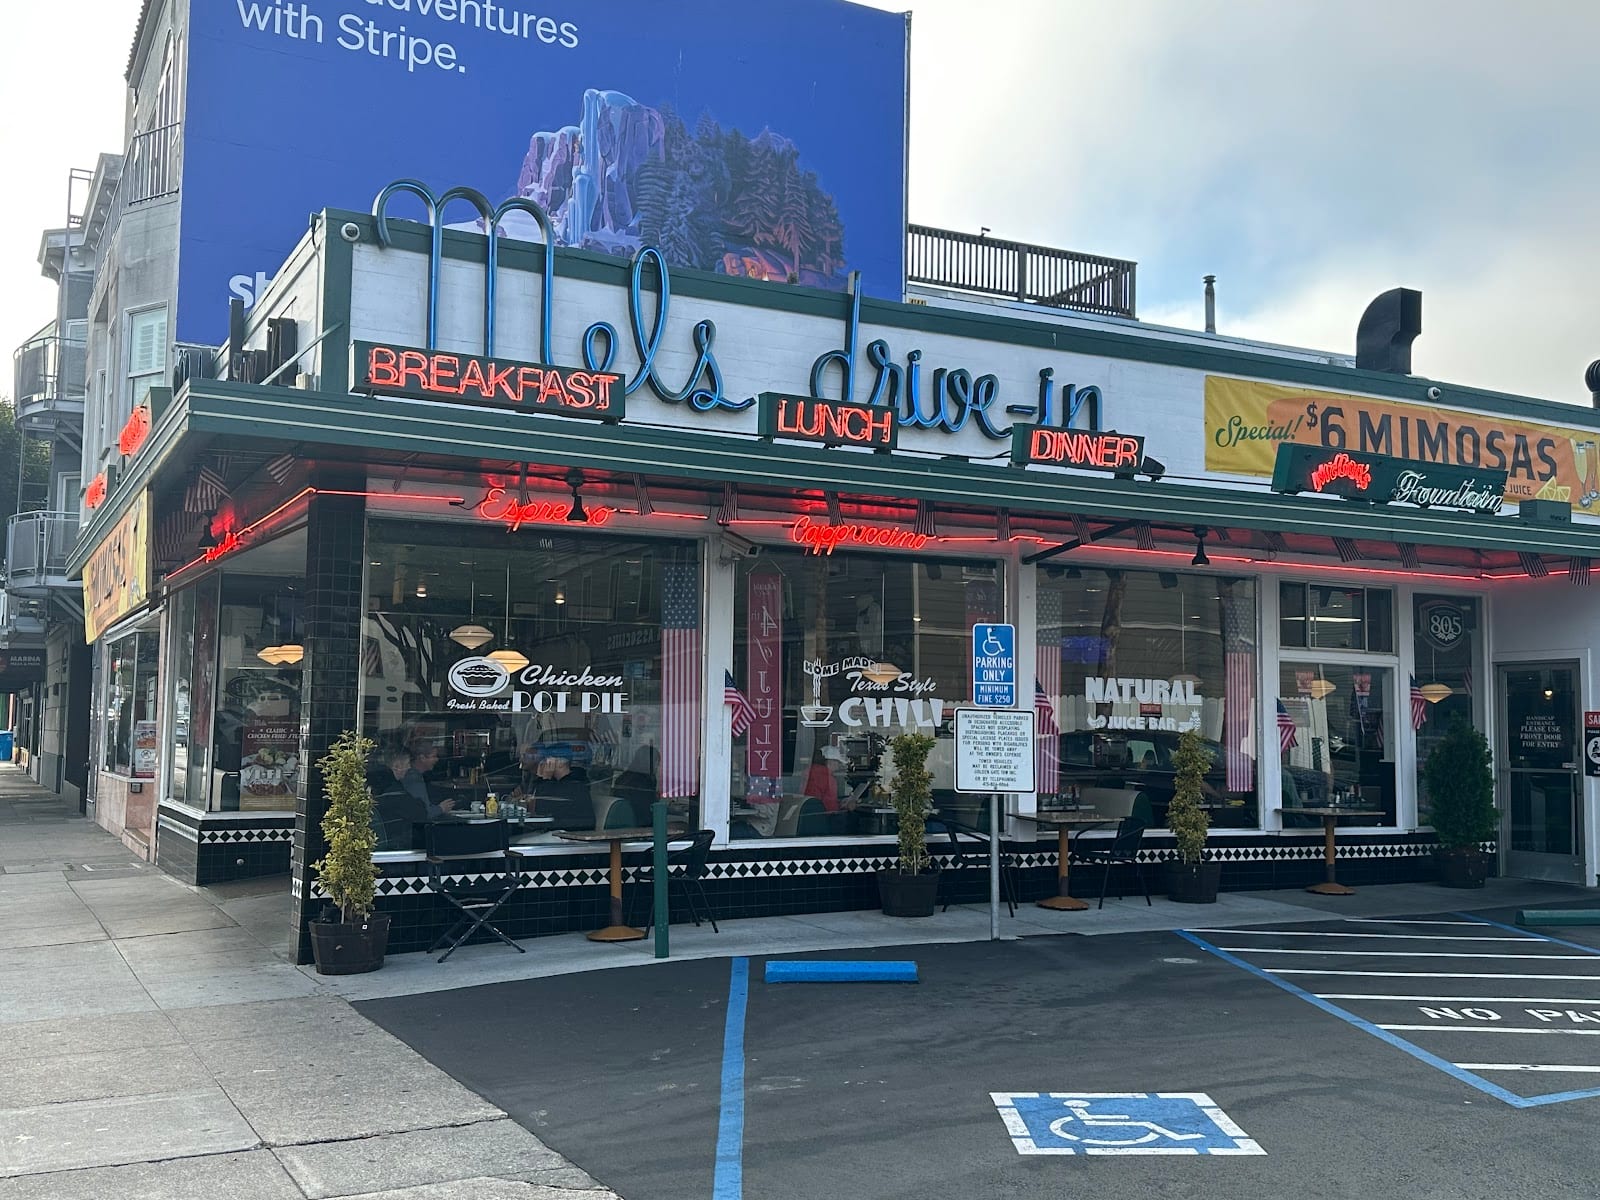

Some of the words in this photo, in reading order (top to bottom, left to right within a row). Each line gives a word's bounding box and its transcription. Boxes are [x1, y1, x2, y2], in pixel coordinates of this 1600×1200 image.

[365, 0, 579, 48] ventures
[237, 0, 323, 43] with
[337, 13, 465, 73] Stripe.
[368, 346, 620, 411] BREAKFAST
[777, 399, 892, 444] LUNCH
[1030, 428, 1139, 470] DINNER
[1215, 414, 1304, 447] Special!
[1306, 401, 1346, 449] $6
[1359, 410, 1557, 481] MIMOSAS
[1396, 469, 1504, 513] Fountain
[1509, 483, 1532, 496] JUICE
[480, 488, 618, 532] Espreso
[793, 515, 937, 556] Cappuccino
[1430, 615, 1462, 635] 805
[803, 660, 840, 677] HOME
[975, 656, 1013, 669] PARKING
[519, 664, 623, 687] Chicken
[845, 671, 890, 693] Texas
[893, 672, 937, 696] Style
[982, 670, 1006, 682] ONLY
[977, 695, 993, 703] FINE
[994, 695, 1011, 704] $250
[980, 686, 1009, 694] MINIMUM
[1085, 676, 1203, 706] NATURAL
[446, 698, 476, 710] Fresh
[478, 699, 511, 710] Baked
[512, 691, 572, 713] POT
[581, 691, 629, 714] PIE
[838, 696, 944, 728] CHILI
[1107, 715, 1146, 731] JUICE
[1148, 716, 1177, 732] BAR
[1547, 725, 1561, 733] USE
[1521, 740, 1535, 748] FOR
[1543, 733, 1562, 741] DOOR
[1417, 1006, 1502, 1021] NO
[1524, 1008, 1600, 1023] PA
